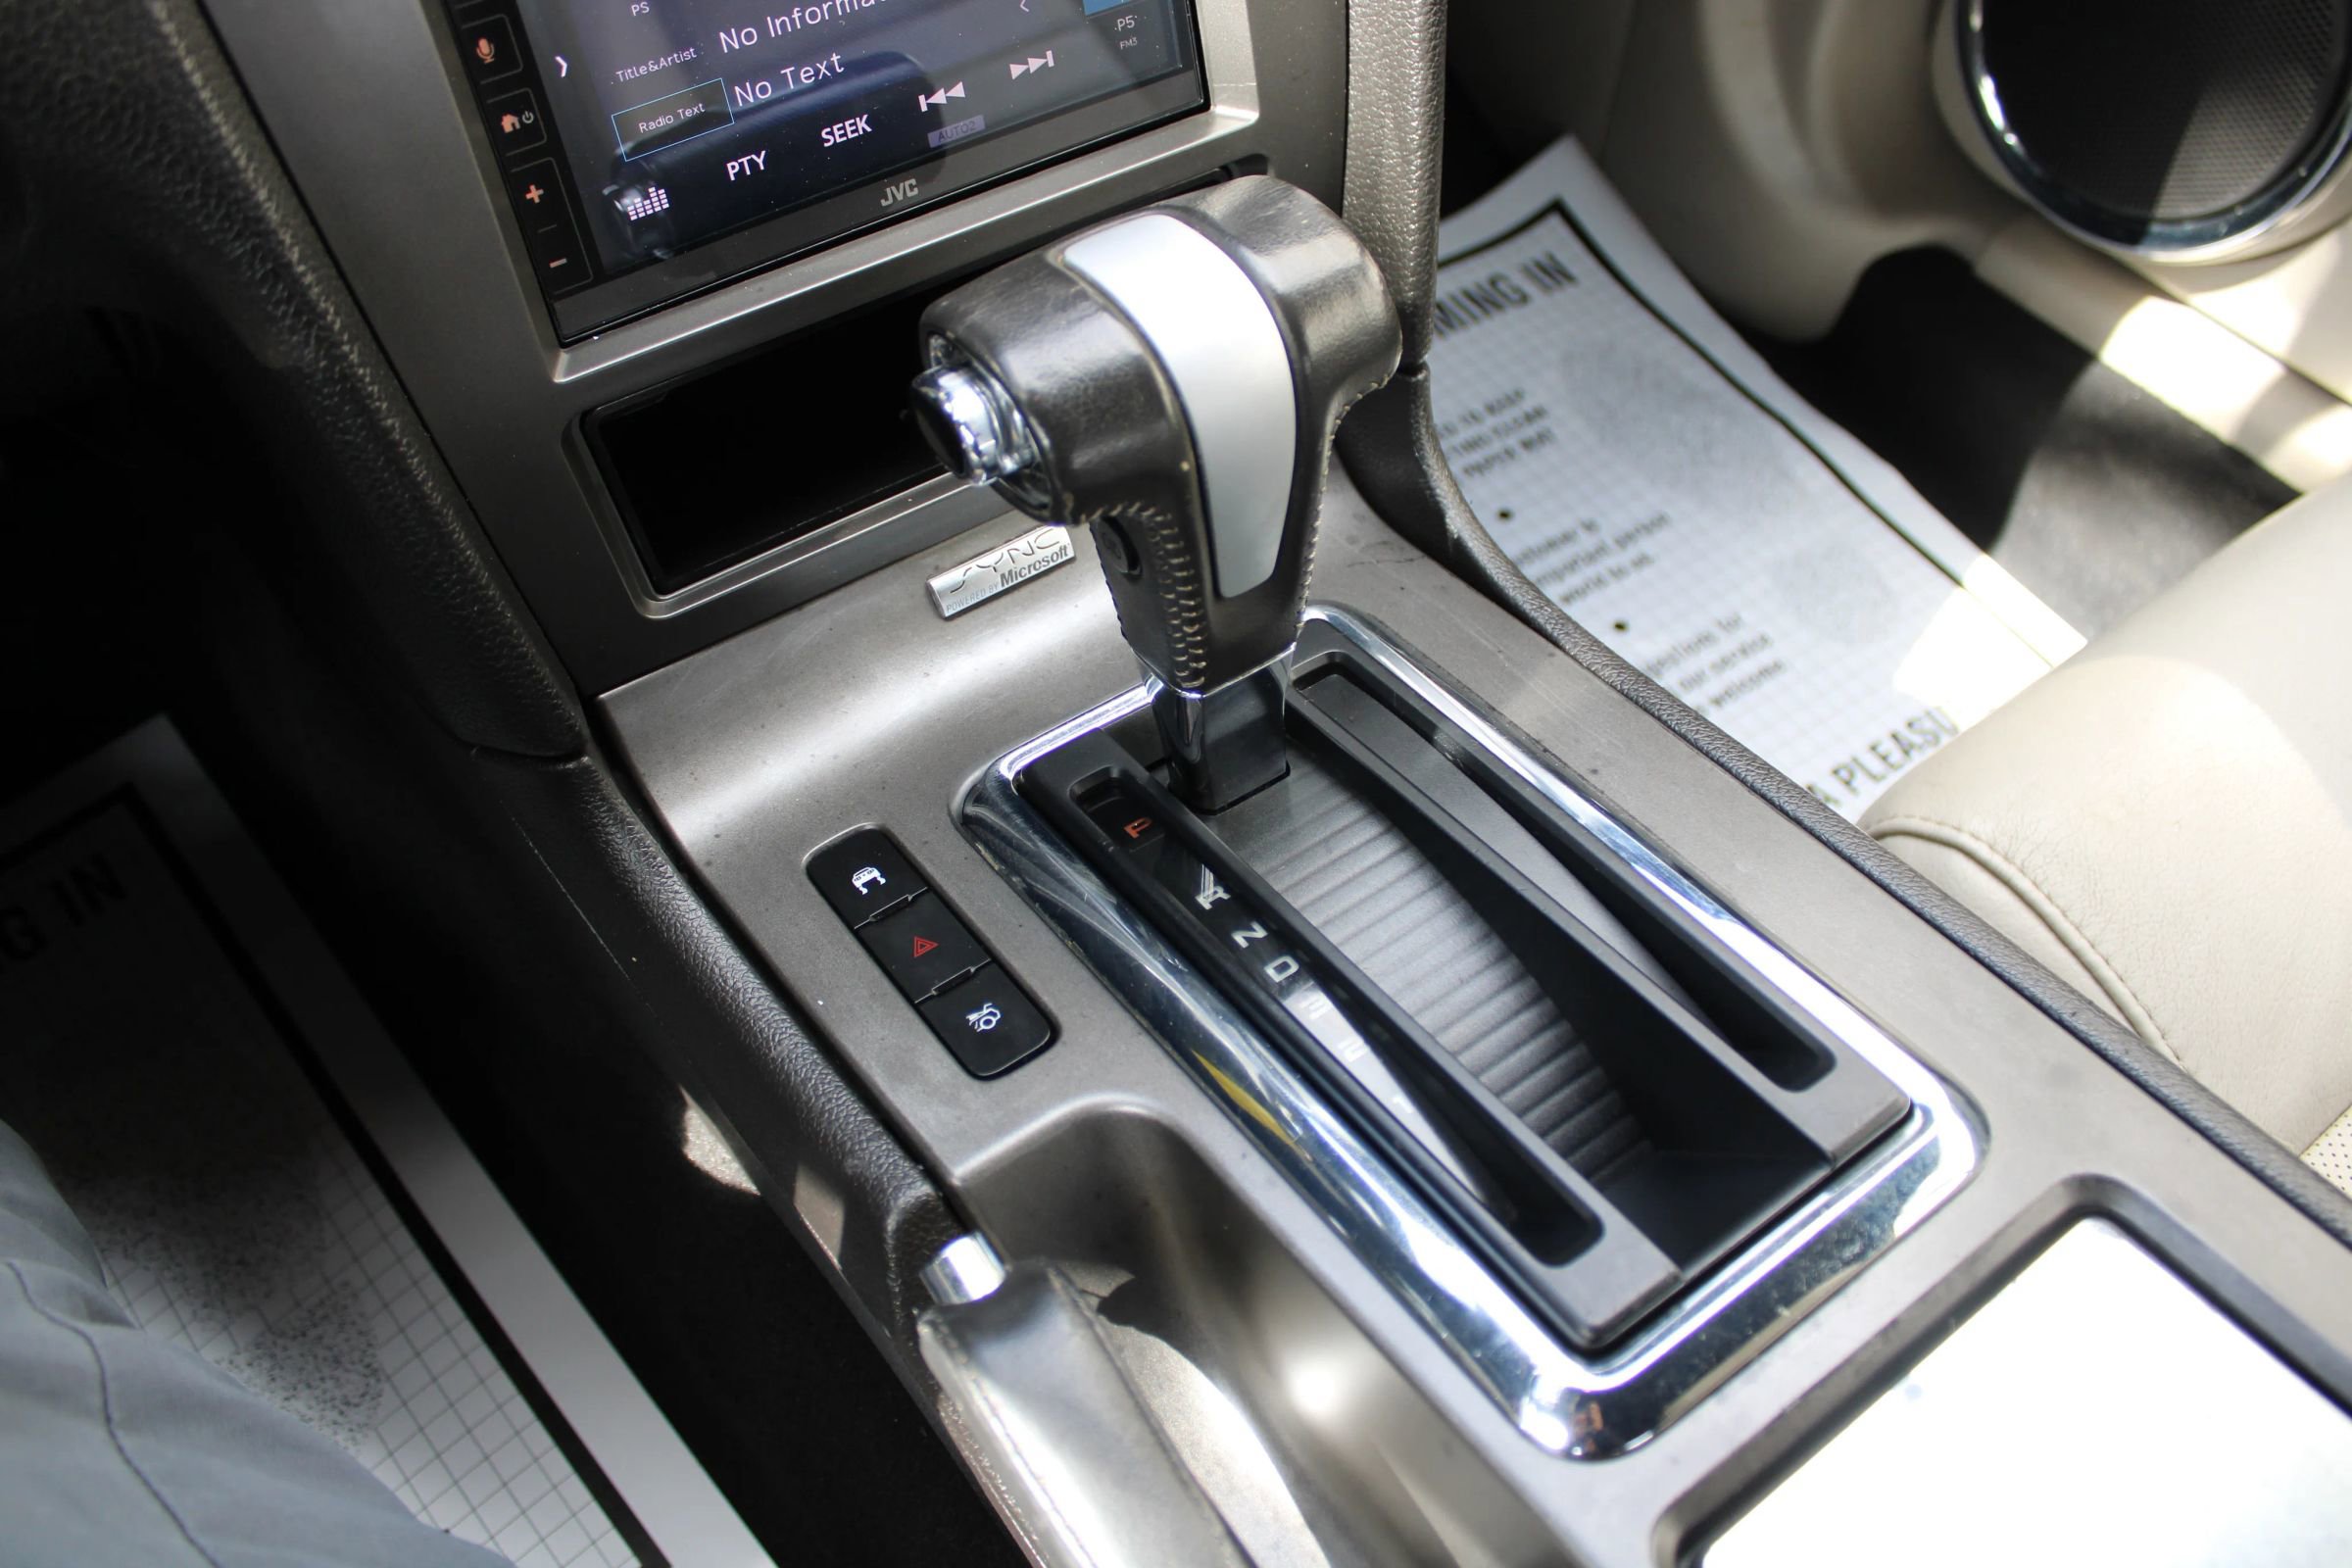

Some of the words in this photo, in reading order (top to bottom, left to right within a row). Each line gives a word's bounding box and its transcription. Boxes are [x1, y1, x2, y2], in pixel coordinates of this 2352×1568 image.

[631, 1, 650, 16] PS
[718, 27, 759, 53] No
[615, 47, 697, 82] Title&Artist
[734, 81, 772, 107] No
[780, 52, 845, 90] Text
[638, 114, 674, 134] Radio
[677, 102, 706, 119] Text
[821, 114, 872, 147] SEEK
[726, 150, 767, 181] PTY
[880, 178, 919, 207] JVC
[1521, 249, 1580, 296] IN
[946, 587, 987, 613] POWERED
[989, 582, 1000, 596] BY
[999, 545, 1069, 588] Microsoft
[1123, 817, 1152, 838] P
[1231, 921, 1268, 949] N
[1264, 956, 1299, 982] D
